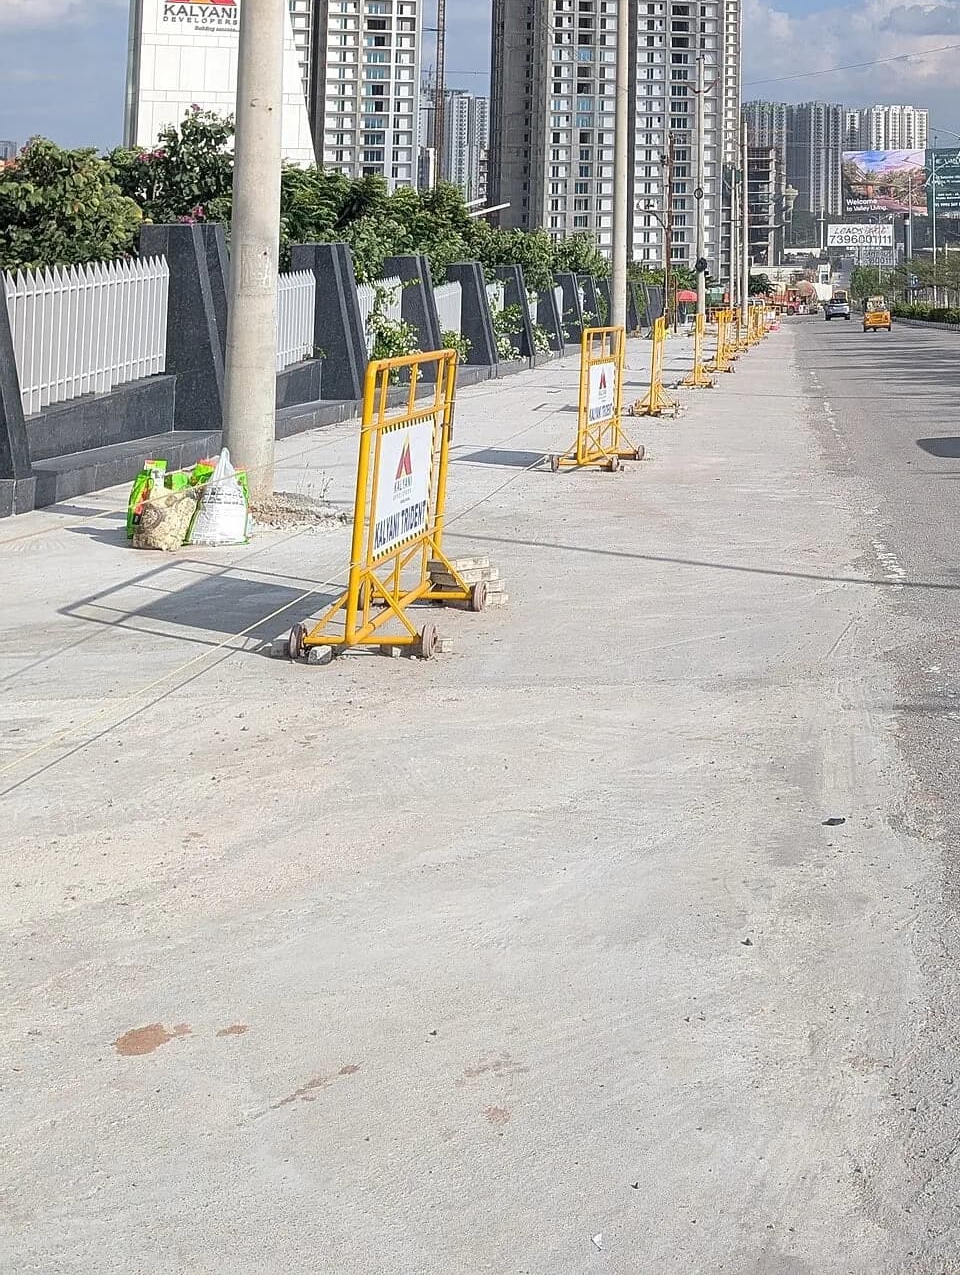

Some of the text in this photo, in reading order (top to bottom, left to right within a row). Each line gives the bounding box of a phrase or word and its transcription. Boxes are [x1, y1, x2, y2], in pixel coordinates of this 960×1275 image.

[163, 4, 238, 19] KALYANI
[162, 16, 238, 25] DEVELOPERS
[829, 234, 892, 244] 7396001111
[374, 500, 426, 550] KALYANI TRIDENT
